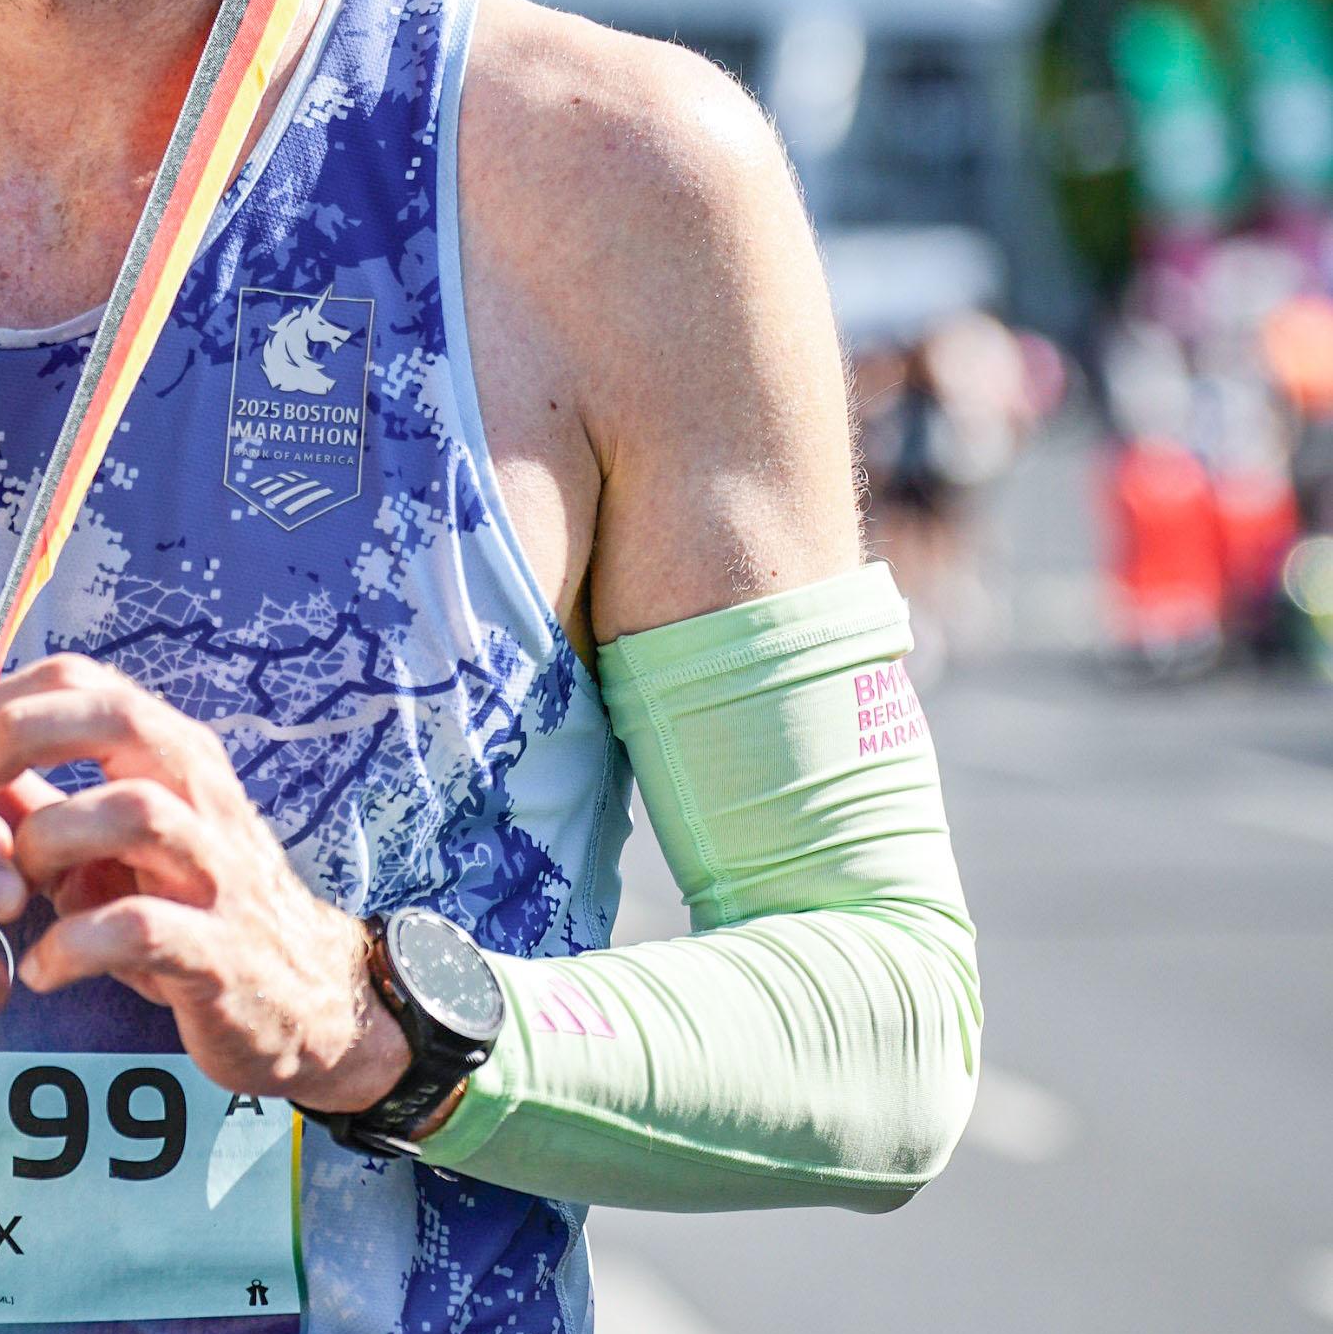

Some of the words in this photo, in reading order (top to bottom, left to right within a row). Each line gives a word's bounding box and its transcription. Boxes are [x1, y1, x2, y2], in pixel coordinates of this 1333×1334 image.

[236, 398, 280, 418] 2025
[283, 403, 359, 424] BOSTON
[234, 420, 357, 446] MARATHON
[233, 446, 269, 459] BANK
[273, 450, 290, 460] OF
[293, 452, 355, 465] AMERICA
